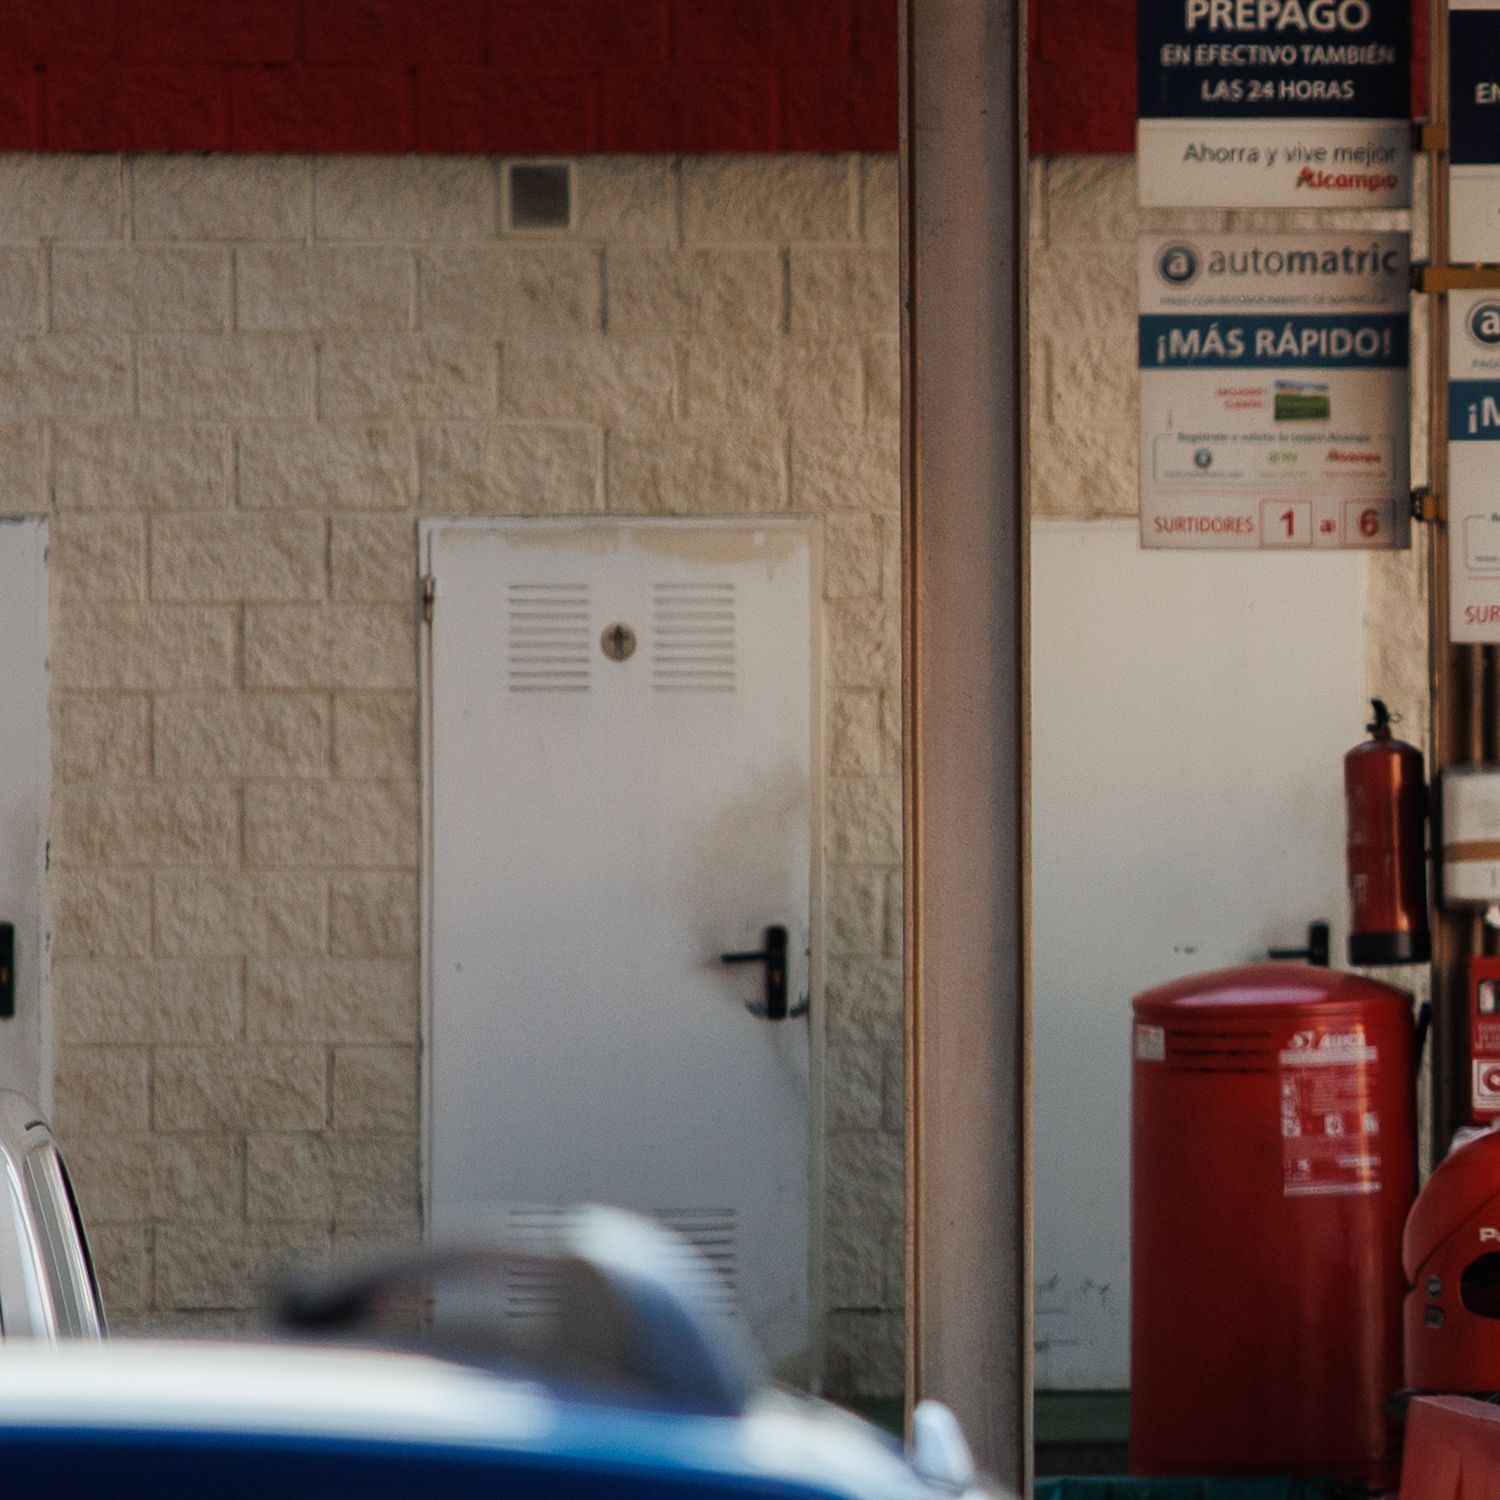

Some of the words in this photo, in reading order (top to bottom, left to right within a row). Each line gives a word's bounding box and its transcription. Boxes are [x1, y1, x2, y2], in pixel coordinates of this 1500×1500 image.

[1185, 0, 1370, 32] PREPAGO
[1161, 44, 1191, 66] EN
[1195, 44, 1296, 66] EFECTIVO
[1202, 80, 1242, 99] LAS
[1246, 80, 1275, 99] 24
[1280, 79, 1354, 99] HORAS
[1183, 142, 1262, 164] Ahorra
[1267, 149, 1278, 168] y
[1286, 142, 1328, 163] vive
[1333, 142, 1397, 168] mejor
[1208, 245, 1398, 276] automatric
[1254, 323, 1392, 357] RÁPIDO!
[1154, 516, 1253, 533] SURTIDORES
[1281, 510, 1295, 536] 1
[1358, 509, 1379, 535] 6
